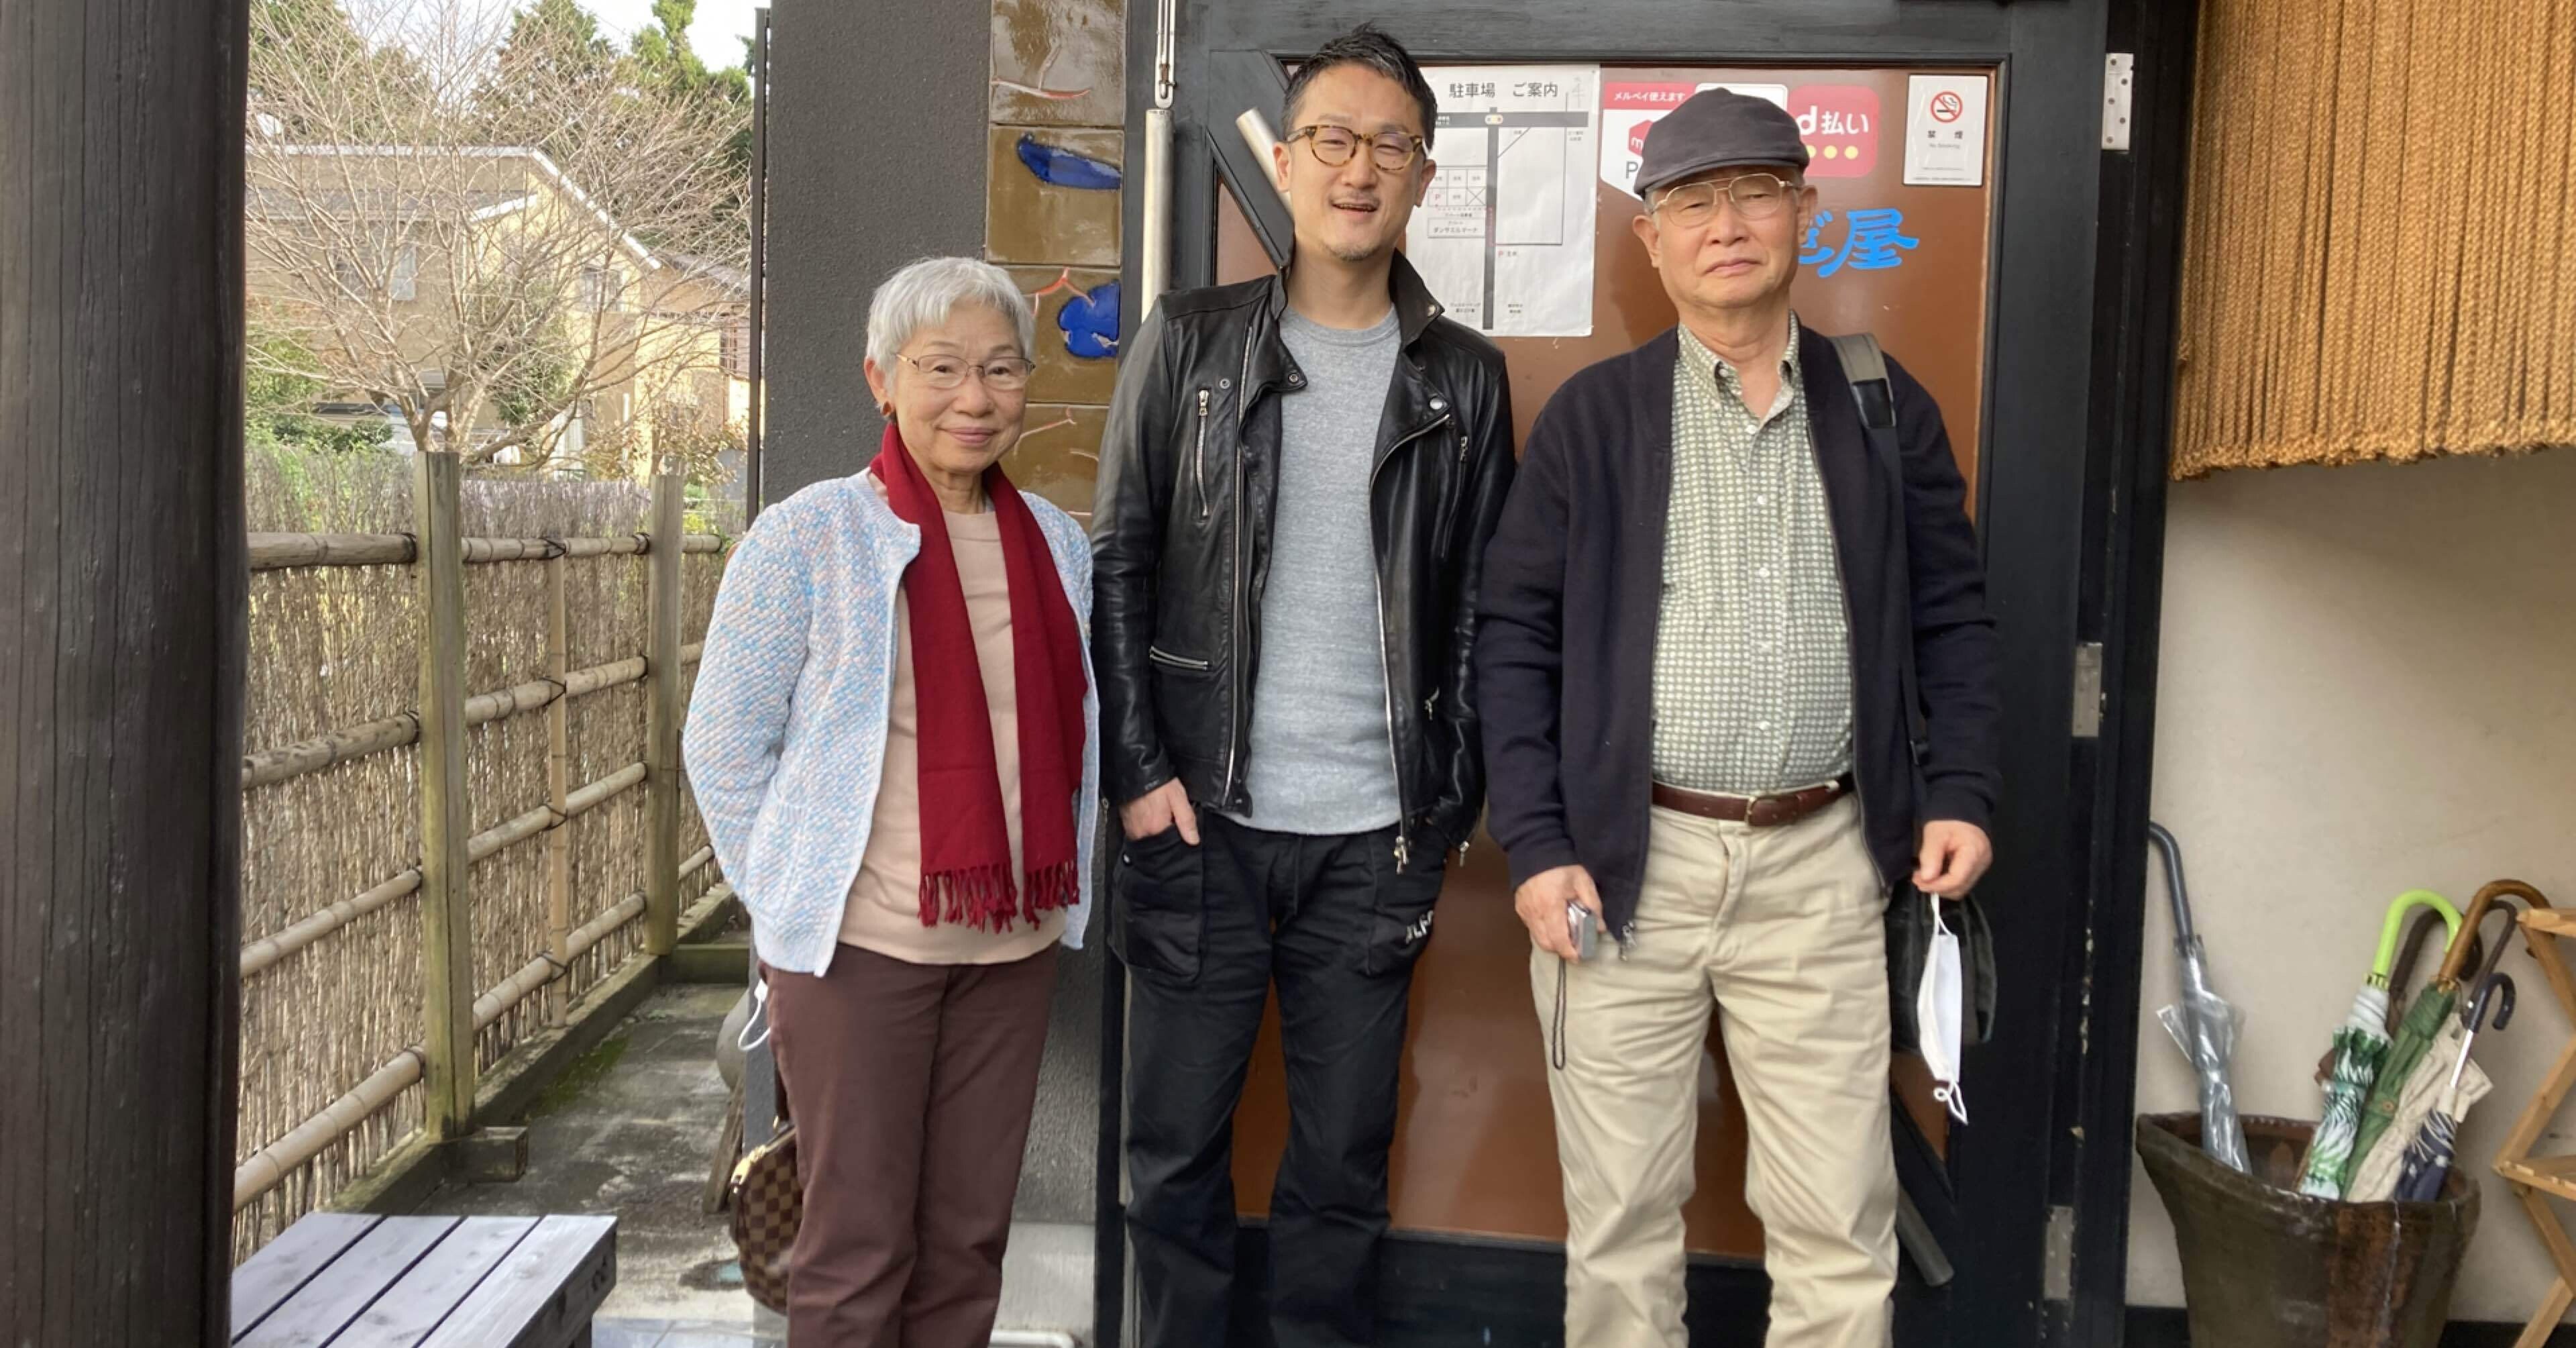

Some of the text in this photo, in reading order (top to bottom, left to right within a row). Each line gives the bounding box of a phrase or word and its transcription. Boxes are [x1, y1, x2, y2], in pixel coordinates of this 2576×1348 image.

[1449, 82, 1558, 98] 駐車場 ご案内
[1613, 91, 1686, 103] メルペイ使えます
[1796, 105, 1869, 136] d払い
